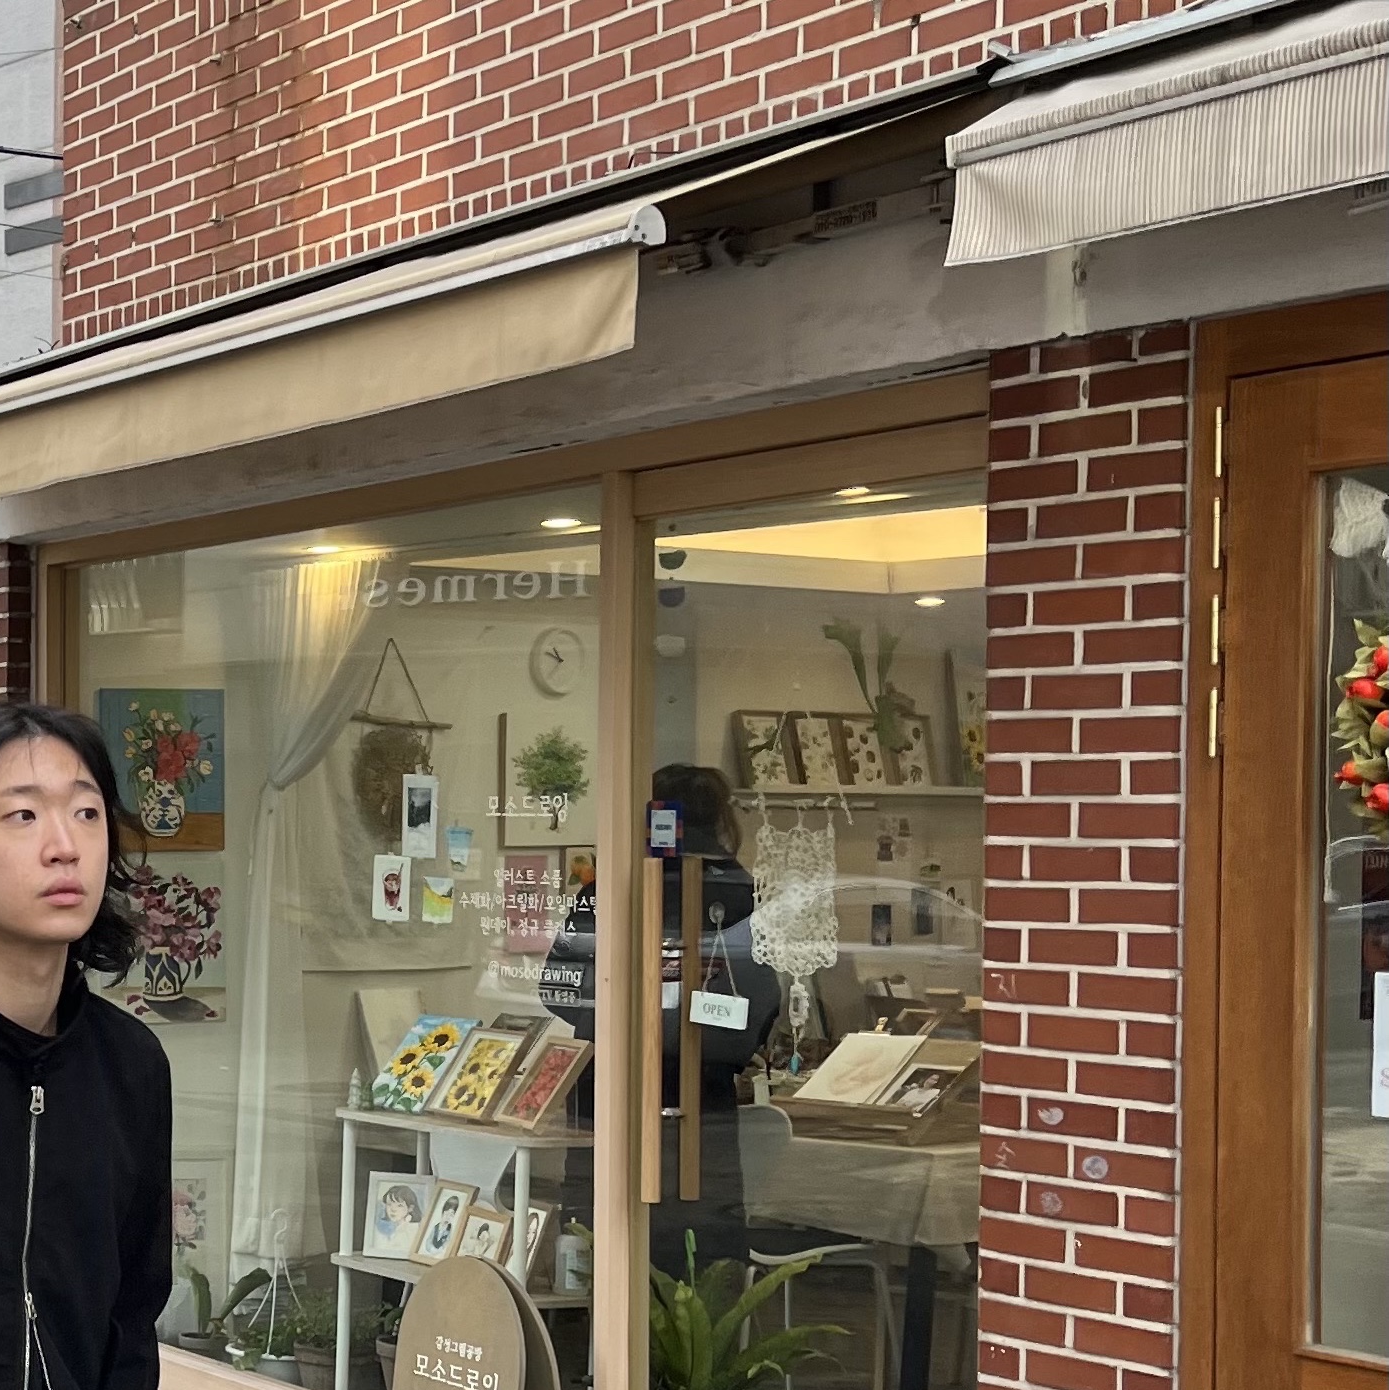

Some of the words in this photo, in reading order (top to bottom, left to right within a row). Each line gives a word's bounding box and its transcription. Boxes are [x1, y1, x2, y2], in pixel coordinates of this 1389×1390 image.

[485, 792, 569, 823] 모소드로잉
[493, 867, 536, 888] 일러스트
[702, 1002, 732, 1017] OPEN
